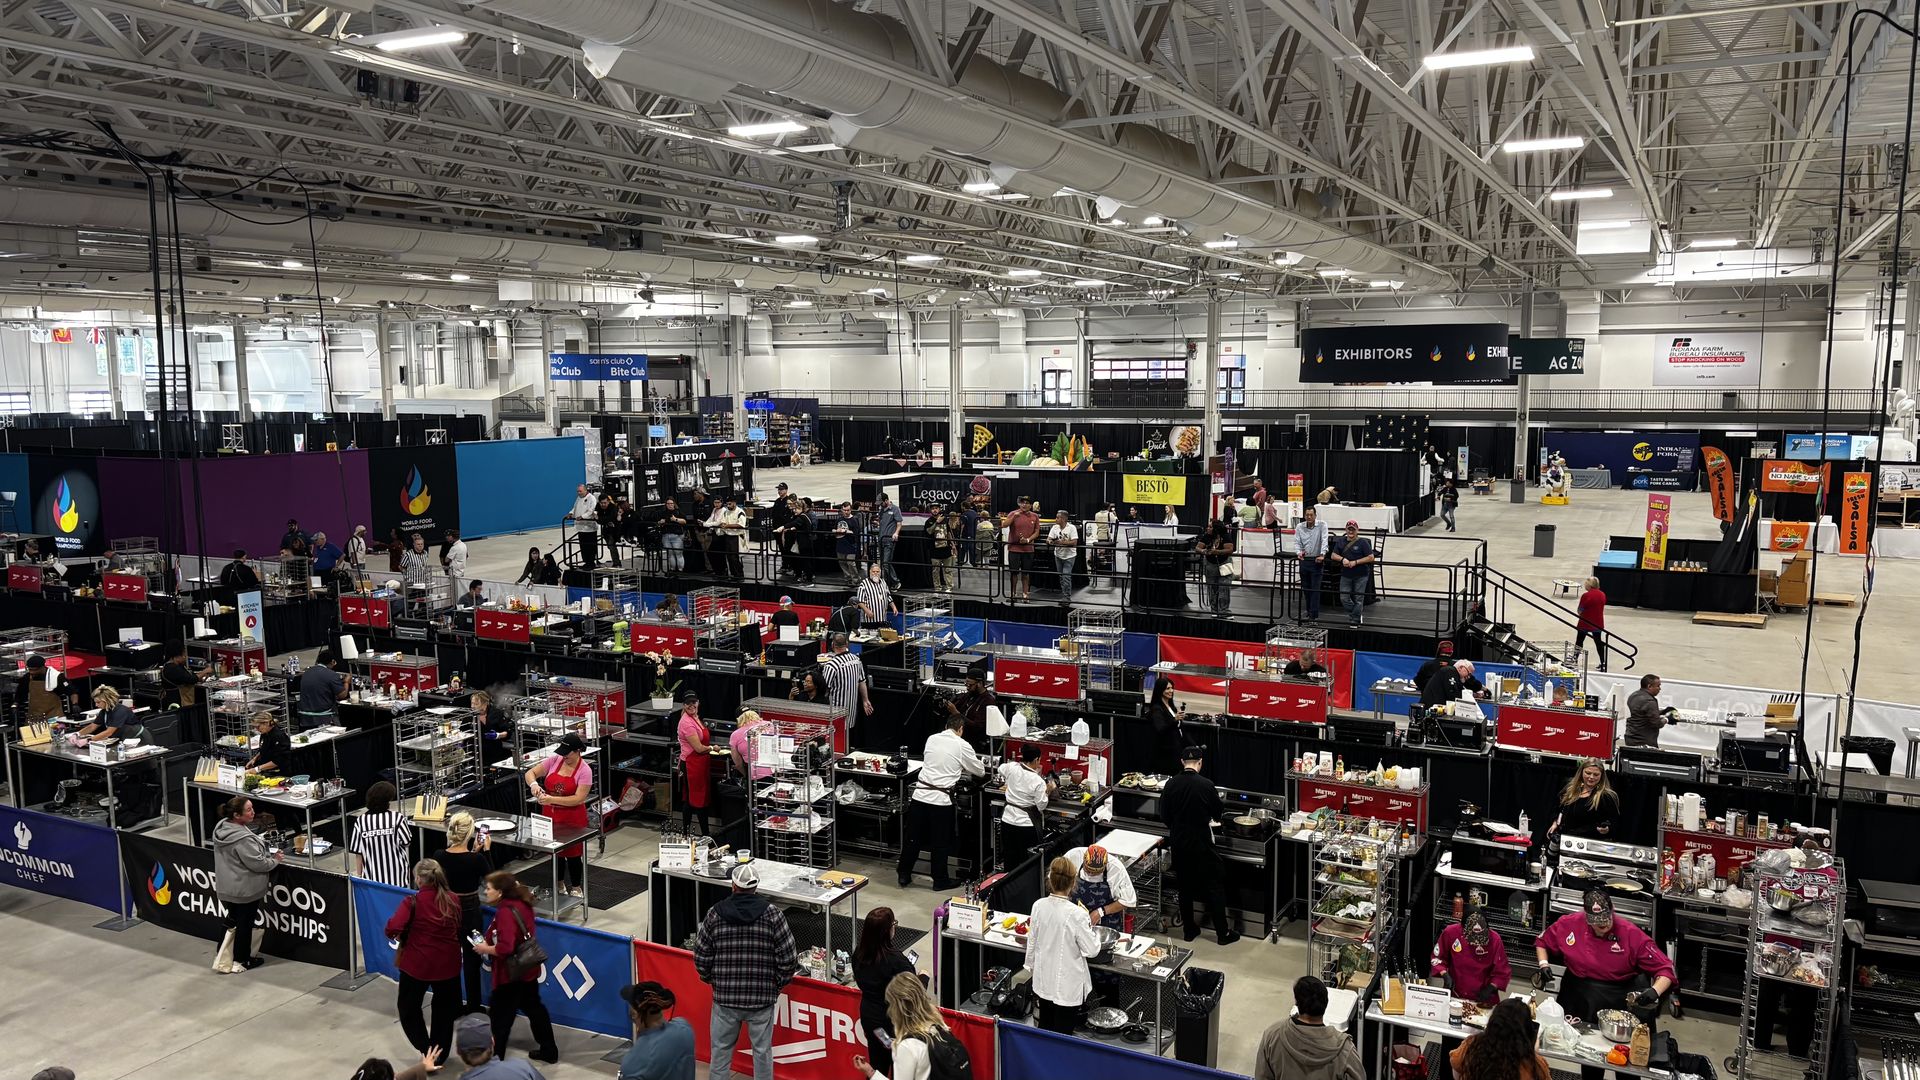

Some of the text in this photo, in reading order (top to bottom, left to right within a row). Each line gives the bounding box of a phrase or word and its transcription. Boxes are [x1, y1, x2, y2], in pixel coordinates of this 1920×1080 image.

[1335, 347, 1413, 360] EXHIBITORS
[610, 357, 626, 365] club
[1548, 356, 1568, 370] AG
[561, 366, 582, 376] Club
[610, 367, 645, 376] Bite Club
[1146, 439, 1168, 451] Duck
[1632, 477, 1649, 486] pork
[912, 485, 960, 504] Legacy
[1846, 494, 1866, 503] FRESH
[918, 500, 948, 511] Mer
[1848, 501, 1860, 551] SALSA
[744, 609, 773, 626] MET
[1241, 692, 1258, 700] METRO
[1512, 722, 1600, 738] METRO METRO METRO
[1315, 788, 1412, 807] METRO METRO METRO
[361, 826, 395, 838] CHEFEREE
[1685, 840, 1712, 850] METRO
[16, 868, 45, 884] CHEF
[172, 862, 217, 890] WOR
